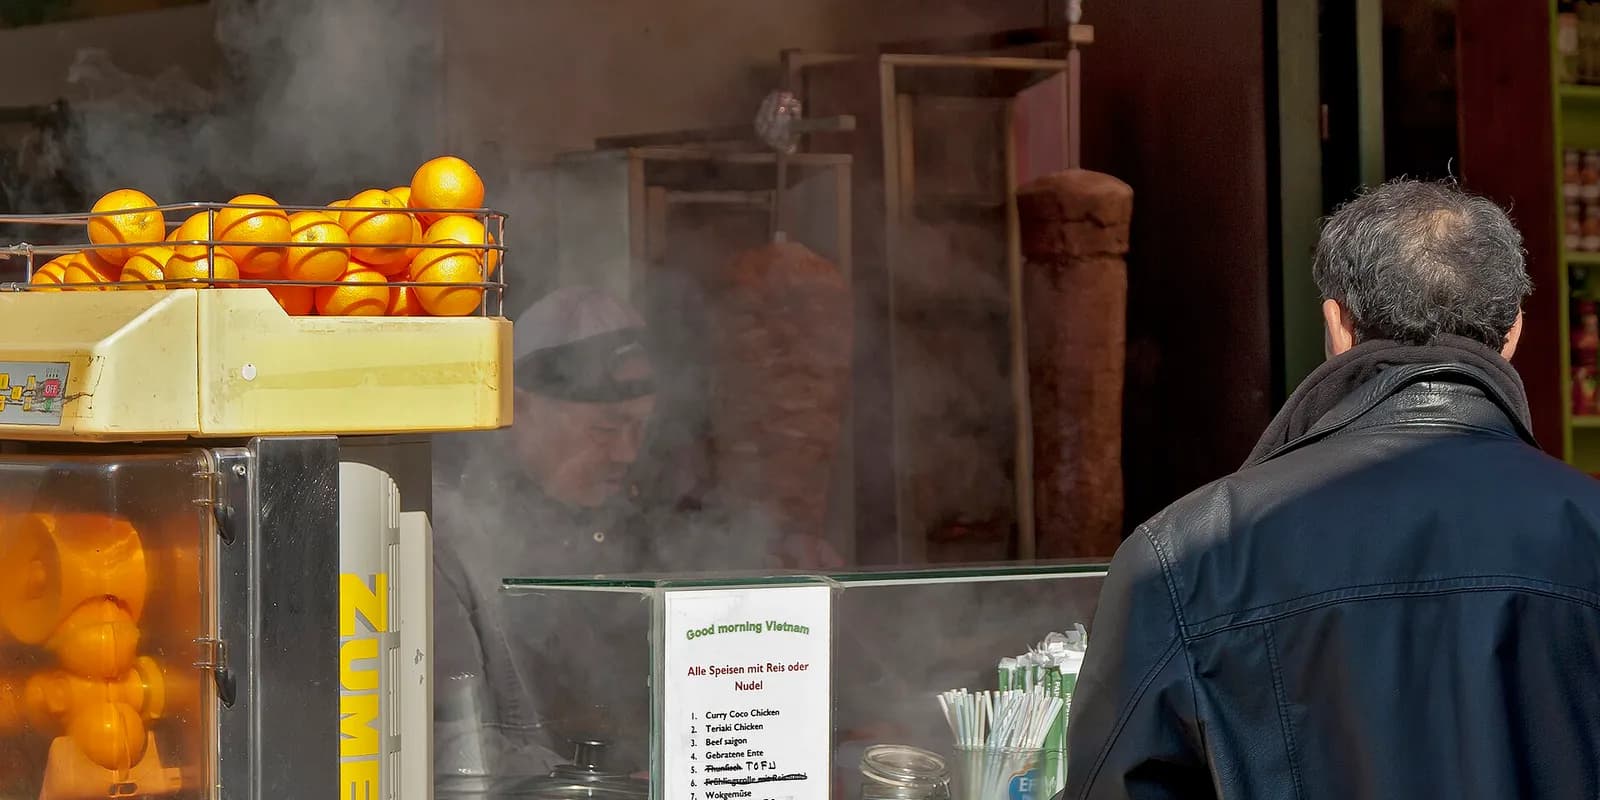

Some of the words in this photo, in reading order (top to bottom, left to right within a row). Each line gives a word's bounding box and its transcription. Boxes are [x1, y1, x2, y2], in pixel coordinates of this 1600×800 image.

[686, 624, 715, 640] Good
[718, 620, 763, 634] morning
[766, 620, 810, 635] Vietnam
[687, 666, 707, 677] Alle
[709, 664, 745, 677] Speisen
[747, 664, 764, 674] mit
[766, 662, 785, 673] Reis
[788, 661, 809, 672] oder
[735, 680, 763, 691] Nudel
[691, 712, 698, 720] 1.
[705, 711, 727, 721] Curry
[729, 710, 749, 718] Coco
[750, 708, 780, 717] Chicken
[690, 725, 698, 734] 2.
[705, 724, 732, 733] Teriaki
[734, 723, 764, 731] Chicken
[690, 739, 698, 747] 3.
[705, 738, 723, 746] Beef
[724, 737, 748, 747] saigon
[705, 751, 745, 760] Gebratene
[747, 749, 764, 757] Ente
[745, 760, 776, 771] TOFU
[690, 779, 697, 787] 6.
[705, 789, 752, 800] Wokgemüse
